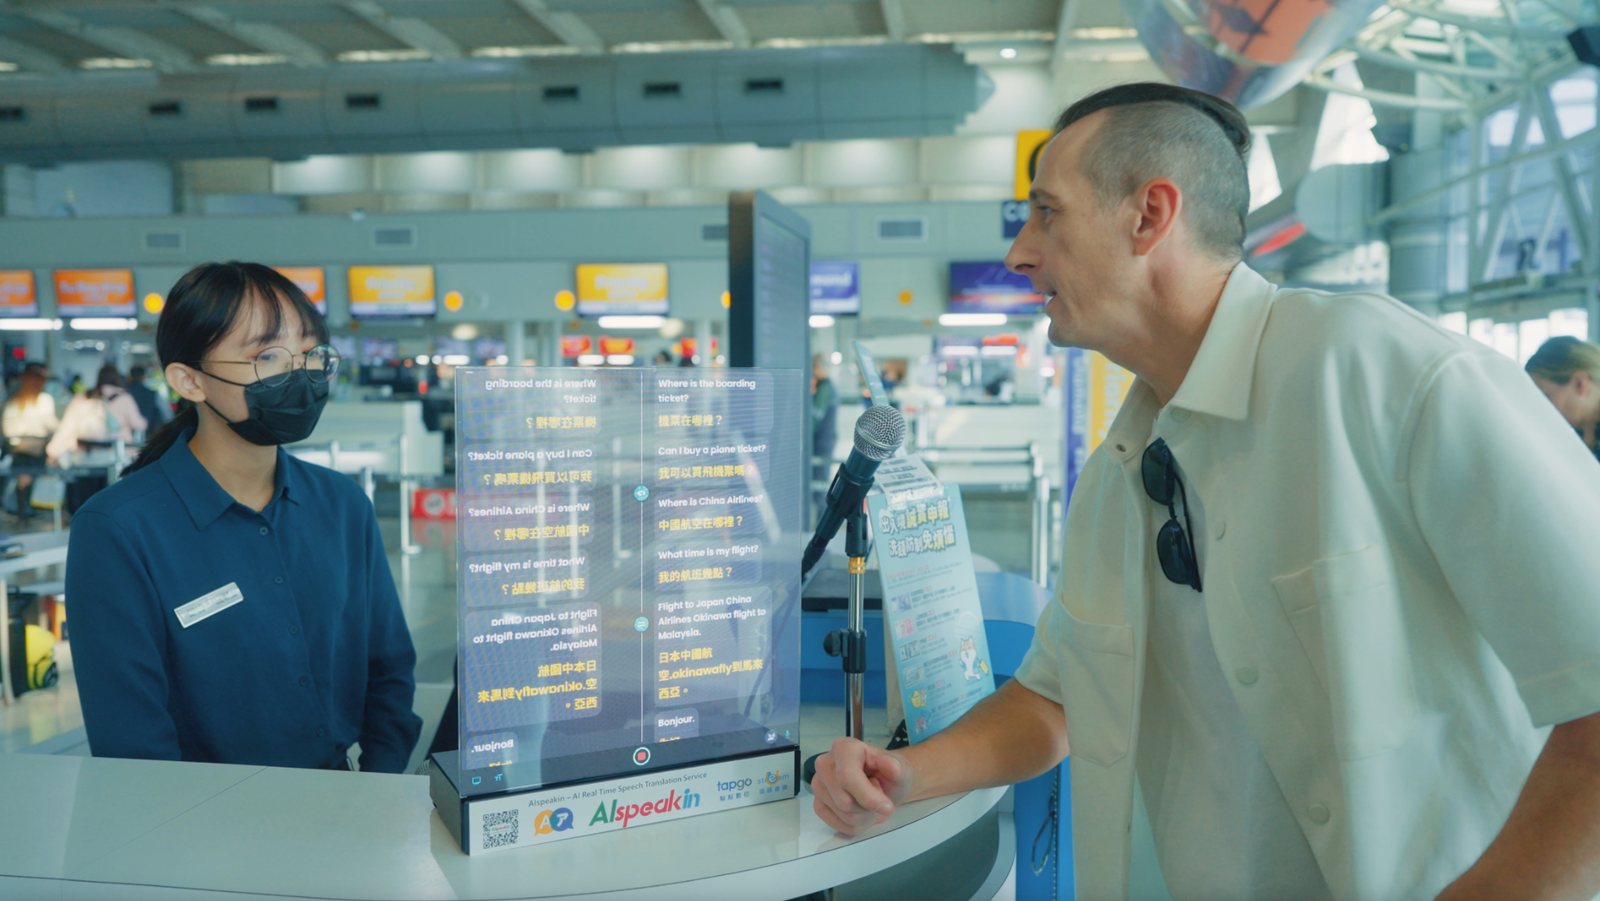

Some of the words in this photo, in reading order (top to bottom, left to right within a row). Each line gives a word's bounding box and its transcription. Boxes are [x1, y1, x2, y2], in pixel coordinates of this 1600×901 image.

[658, 379, 688, 388] Where
[690, 378, 698, 388] is
[699, 378, 714, 388] the
[715, 378, 757, 390] boarding
[658, 393, 689, 403] ticket?
[658, 446, 678, 456] Can
[683, 446, 703, 457] buy
[702, 447, 709, 455] a
[710, 445, 736, 456] plane
[737, 443, 766, 453] ticket?
[658, 498, 688, 508] Where
[689, 497, 698, 507] is
[698, 496, 726, 506] China
[727, 494, 764, 504] Airlines?
[658, 550, 684, 560] What
[684, 549, 706, 559] time
[706, 547, 714, 557] is
[715, 547, 731, 558] my
[731, 544, 760, 557] flight?
[658, 601, 684, 613] Flight
[684, 600, 695, 610] to
[695, 598, 725, 610] Japan
[725, 595, 752, 606] China
[658, 614, 692, 626] Airlines
[692, 611, 732, 623] Okinawa
[733, 608, 757, 620] flight
[757, 607, 767, 617] to
[658, 627, 702, 640] Malaysia.
[658, 646, 713, 664] 日本中國航
[657, 714, 696, 729] Bonjour.
[582, 790, 598, 799] Real
[599, 787, 617, 797] Time
[618, 782, 644, 794] Speech
[645, 776, 683, 788] Translation
[683, 772, 708, 782] Service
[716, 778, 753, 792] tapgo
